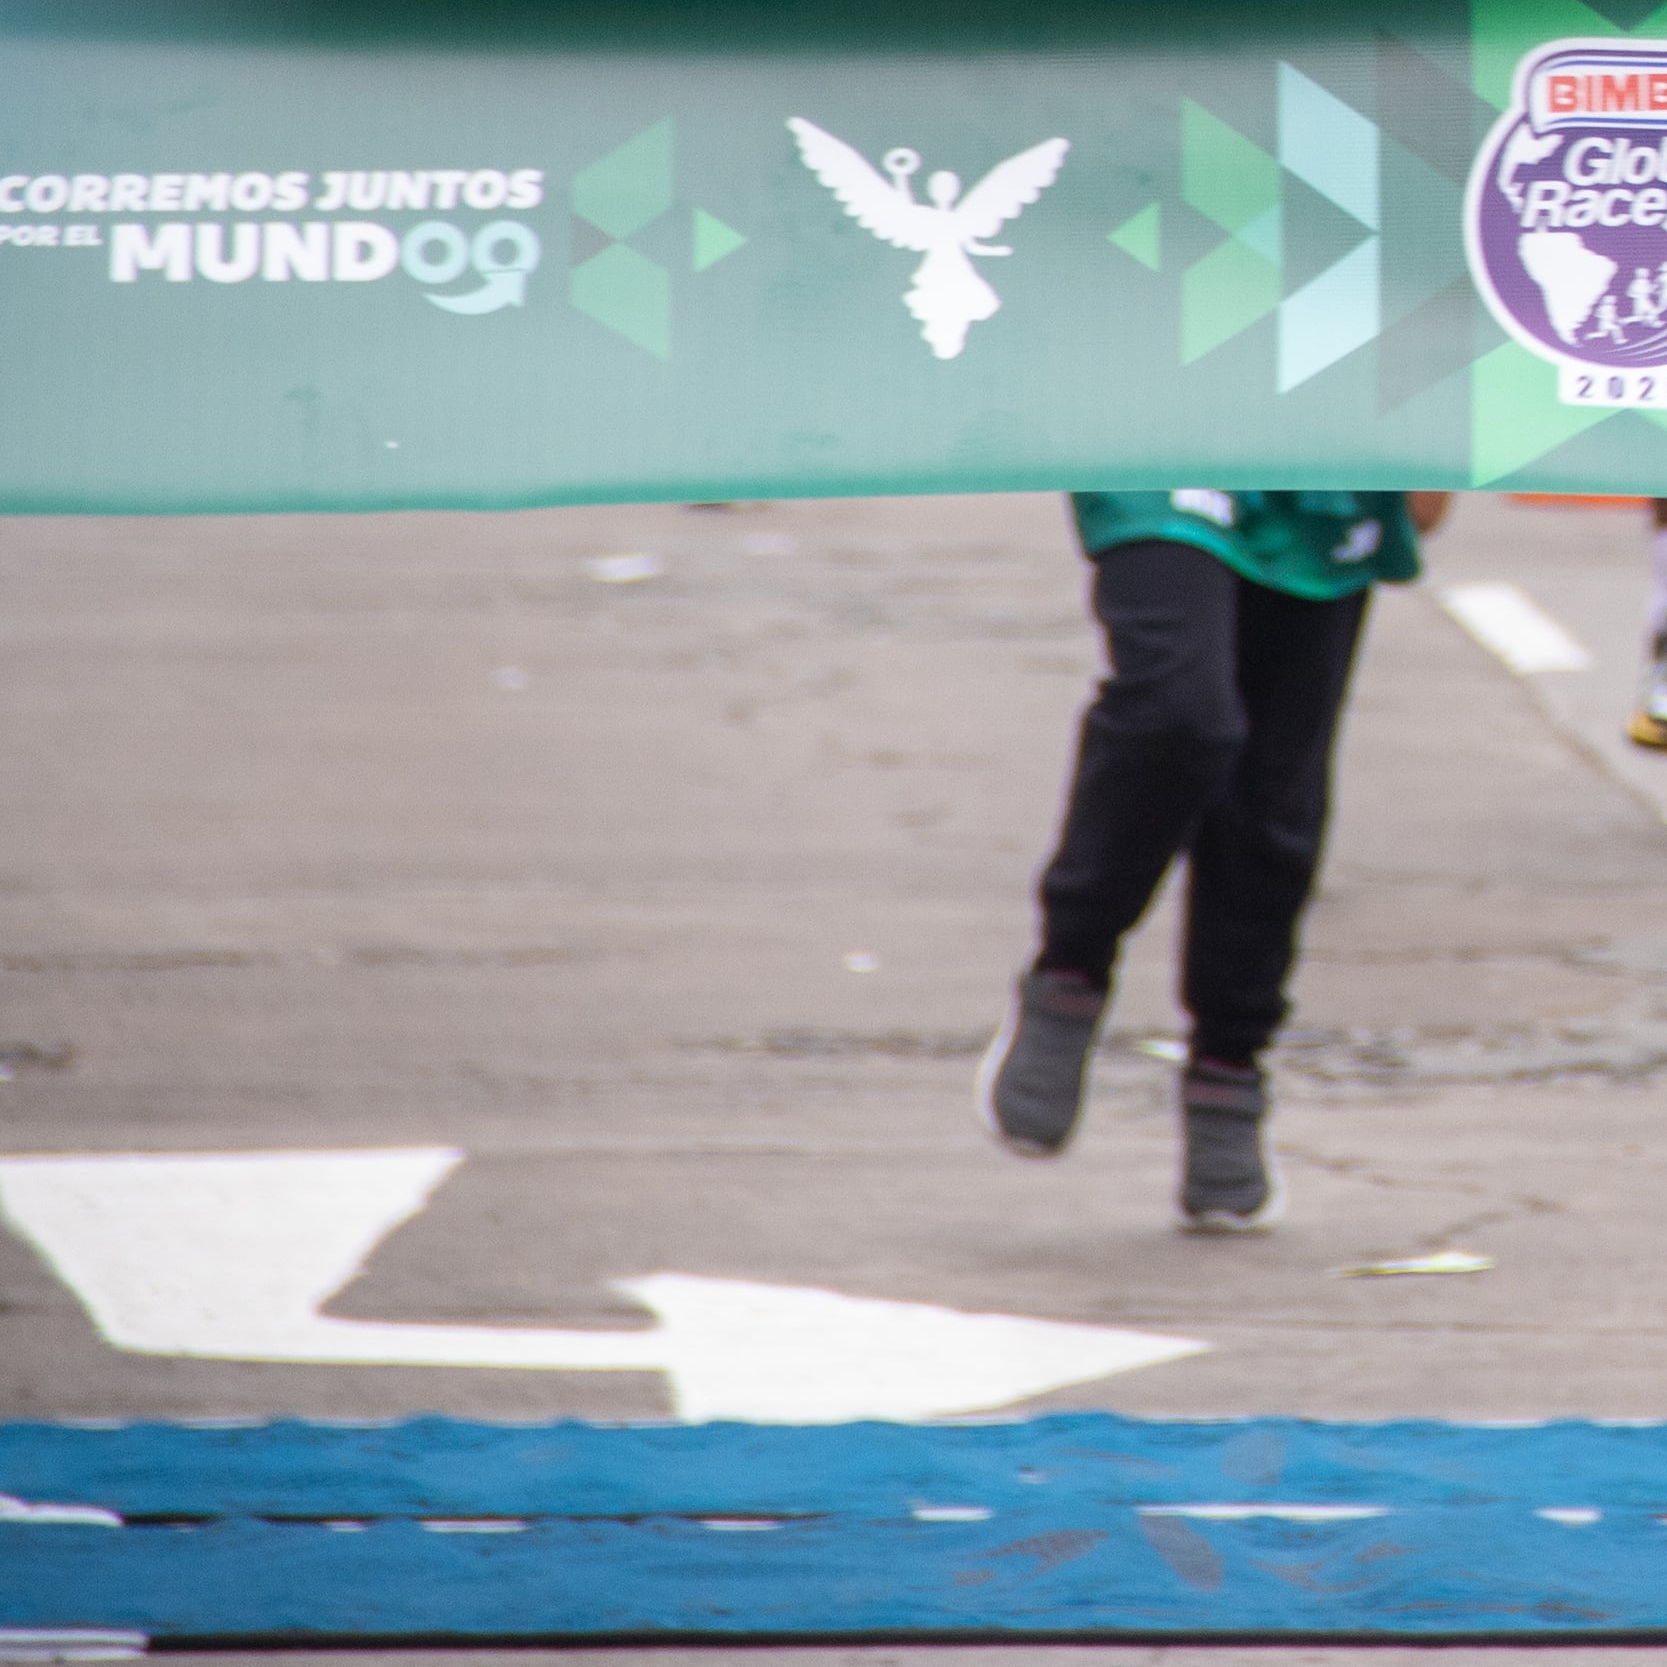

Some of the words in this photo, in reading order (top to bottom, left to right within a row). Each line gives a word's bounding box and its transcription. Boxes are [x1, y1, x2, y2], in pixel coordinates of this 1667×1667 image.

[0, 172, 310, 213] CORREMOS
[314, 168, 545, 211] JUNTOS
[63, 224, 104, 246] EL
